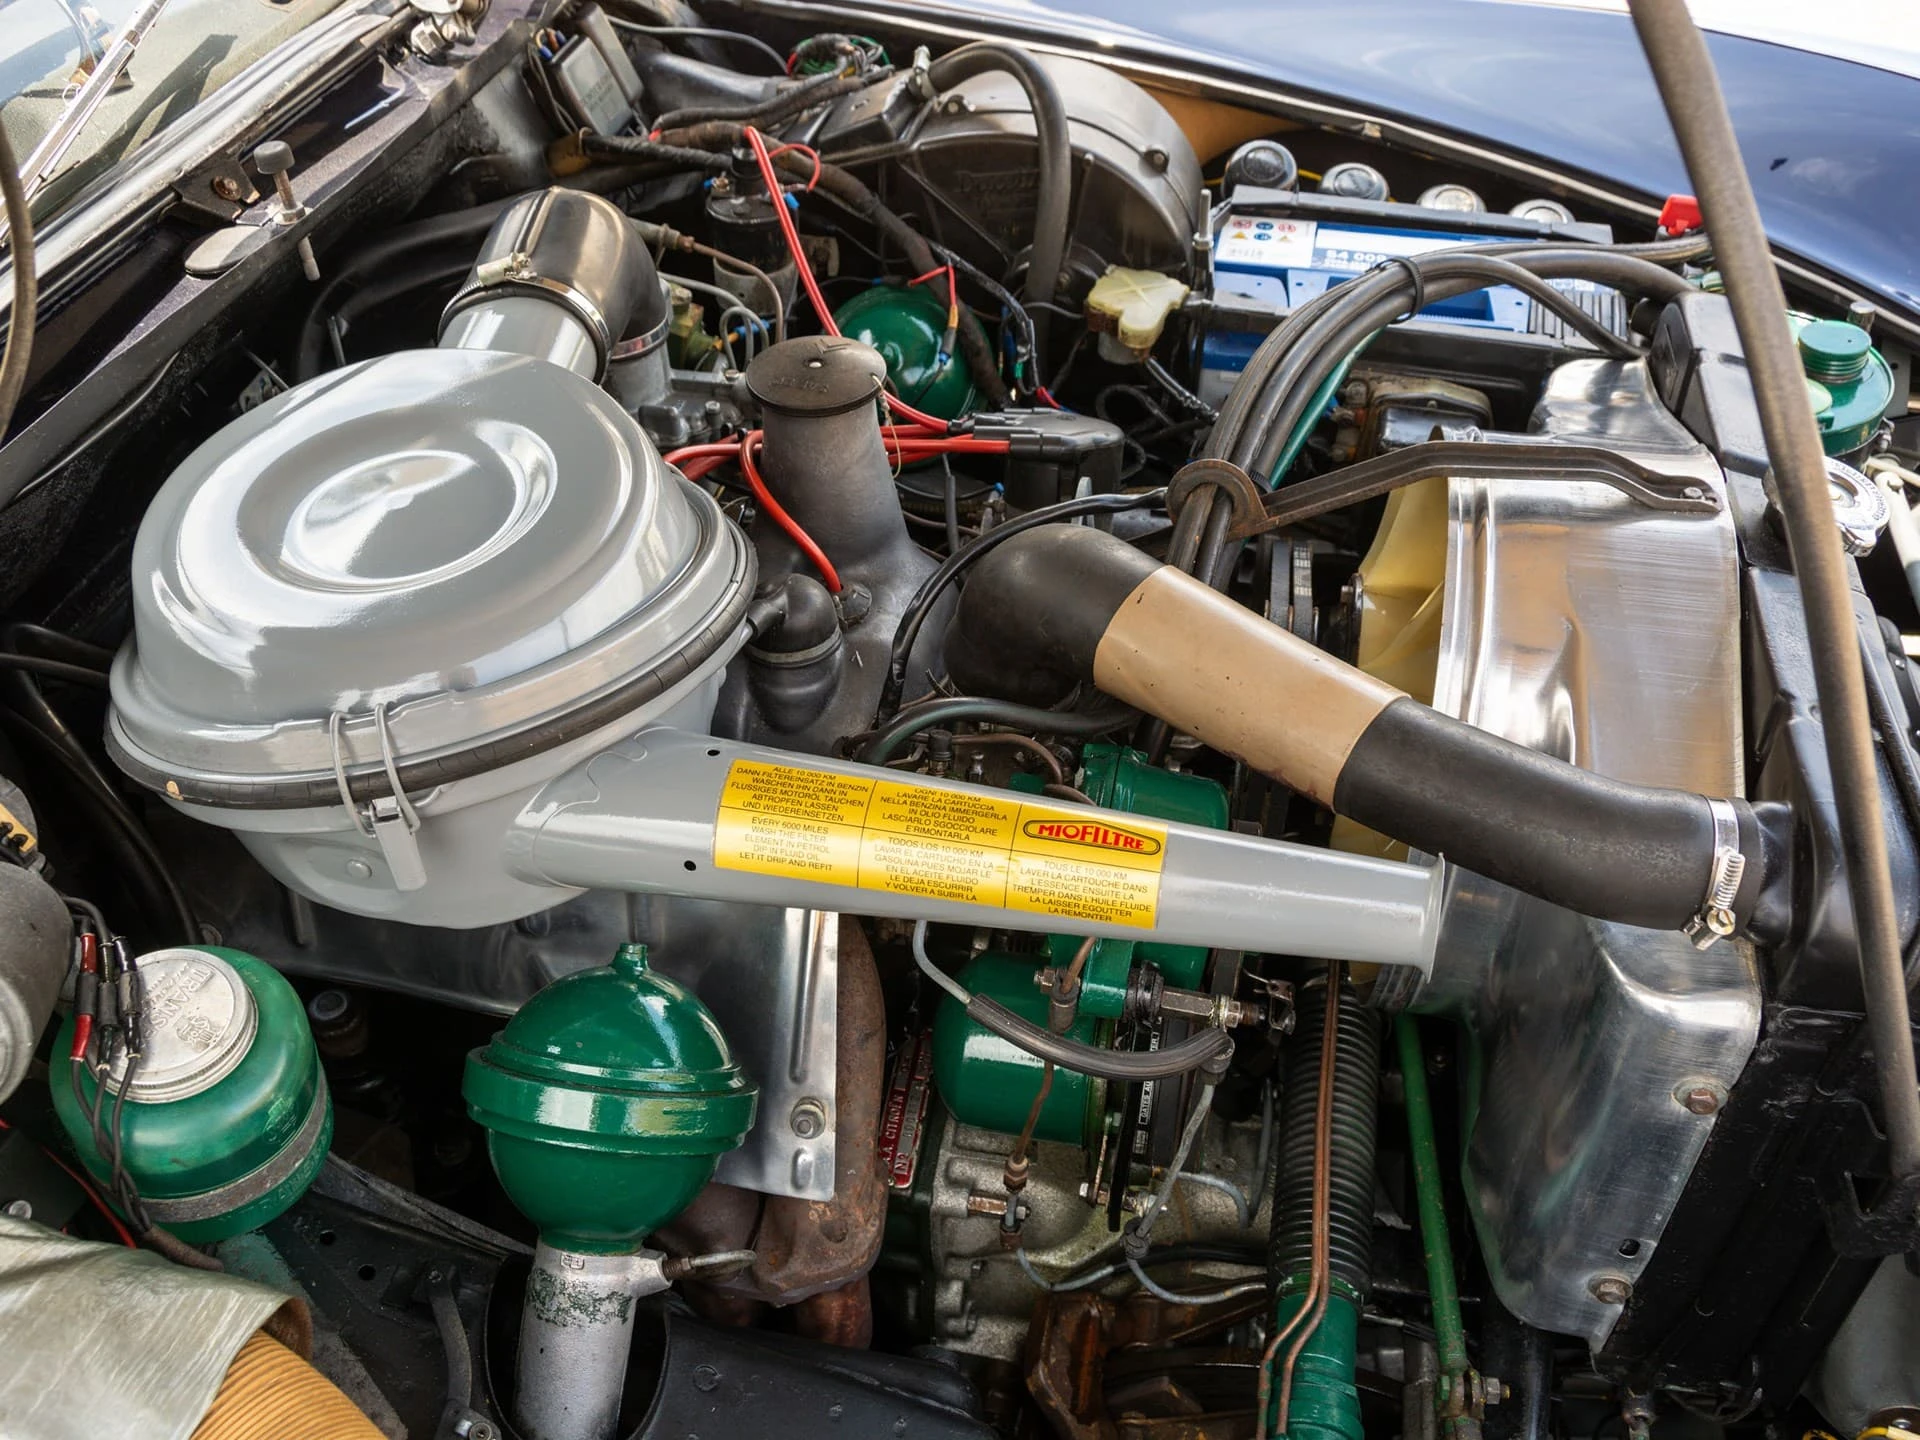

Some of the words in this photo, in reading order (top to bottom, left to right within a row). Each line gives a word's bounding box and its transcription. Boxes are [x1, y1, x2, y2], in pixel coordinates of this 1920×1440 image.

[736, 767, 760, 776] DANN
[761, 771, 826, 786] FILTEREINSATZ
[836, 782, 869, 793] BENZIN
[752, 777, 795, 789] WASCHEN
[796, 783, 810, 792] IHN
[812, 785, 837, 796] DANN
[838, 789, 848, 797] IN
[751, 793, 802, 807] ABTROPFEN
[804, 801, 839, 812] LASSEN
[824, 795, 865, 808] TAUCHEN
[896, 792, 929, 802] LAVARE
[944, 798, 995, 811] CARTUCCIA
[939, 790, 949, 798] 10
[742, 801, 761, 809] UND
[763, 804, 844, 820] WIEDEREINSETZEN
[880, 796, 908, 806] NELLA
[909, 800, 947, 812] BENZINA
[949, 805, 1008, 821] IMMERGERLA
[908, 807, 918, 815] IN
[920, 809, 940, 819] OLIO
[942, 812, 976, 824] FLUIDO
[751, 817, 779, 826] EVERY
[802, 824, 829, 834] MILES
[882, 812, 931, 826] LASCIARLO
[933, 819, 998, 836] SGOCCIOLARE
[913, 826, 970, 841] RIMONTARLA
[751, 826, 776, 835] WASH
[778, 830, 795, 839] THE
[797, 833, 827, 843] FILTER
[1038, 824, 1145, 850] MIOFILTRE
[753, 845, 768, 853] DIP
[769, 847, 778, 855] IN
[780, 848, 804, 859] FLUID
[806, 853, 820, 861] OIL
[786, 840, 794, 848] IN
[797, 842, 831, 854] PETROL
[888, 837, 919, 848] TODOS
[921, 842, 939, 851] LOS
[942, 845, 951, 853] 10
[969, 850, 984, 858] KM
[739, 852, 754, 860] LET
[766, 856, 787, 864] DRIP
[788, 858, 806, 867] AND
[808, 862, 833, 871] REFIT
[874, 854, 919, 867] GASOLINA
[921, 860, 944, 871] PUES
[947, 864, 978, 877] MOJAR
[980, 869, 992, 878] LE
[904, 848, 915, 856] EL
[969, 858, 981, 868] EN
[983, 861, 994, 870] LA
[886, 865, 898, 873] EN
[900, 867, 912, 875] EL
[914, 869, 943, 880] ACEITE
[946, 873, 979, 885] FLUIDO
[1043, 860, 1069, 872] TOUS
[1070, 865, 1081, 874] LE
[1085, 866, 1094, 875] 10
[1113, 872, 1128, 881] KM
[903, 876, 925, 886] DEJA
[927, 879, 973, 893] ESCURRIR
[1020, 868, 1048, 879] LAVER
[1050, 872, 1062, 881] LA
[1064, 873, 1121, 887] CARTOUCHE
[1122, 882, 1148, 894] DANS
[1031, 878, 1081, 892] L'ESSENCE
[1083, 886, 1121, 898] ENSUITE
[1123, 892, 1134, 901] LA
[892, 883, 928, 894] VOLVER
[937, 890, 964, 899] SUBIR
[1012, 884, 1056, 897] TREMPER
[1057, 891, 1082, 901] DANS
[1084, 895, 1117, 907] L'HUILE
[1119, 900, 1152, 912] FLUIDE
[1029, 896, 1041, 904] LA
[1042, 897, 1080, 909] LAISSER
[1082, 904, 1132, 917] EGOUTTER
[1061, 908, 1112, 921] REMONTER
